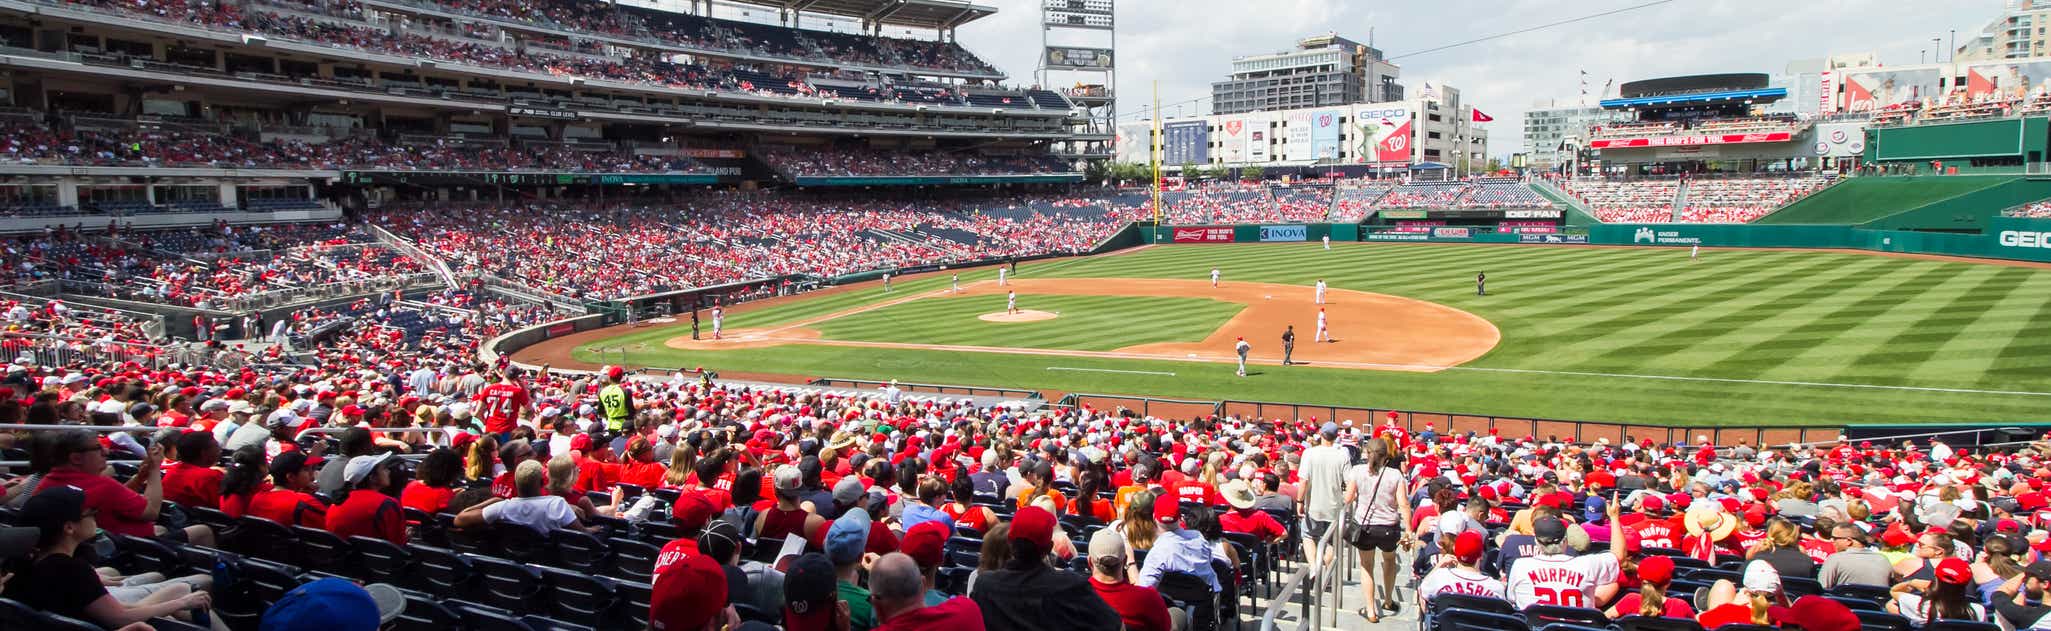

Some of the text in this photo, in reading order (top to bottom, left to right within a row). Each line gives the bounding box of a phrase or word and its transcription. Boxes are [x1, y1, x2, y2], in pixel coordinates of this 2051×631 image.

[1360, 109, 1405, 120] GEICO
[1648, 138, 1665, 147] THIS
[1666, 137, 1689, 146] BUD'S
[1690, 136, 1705, 145] FOR
[601, 175, 623, 183] INOVA
[1534, 210, 1561, 218] FAN
[1271, 229, 1305, 238] INOVA
[604, 394, 620, 408] 45
[486, 396, 514, 419] 74
[714, 478, 732, 491] PER
[1178, 486, 1204, 496] HARPER
[1639, 526, 1671, 538] MURPHY
[1528, 568, 1585, 588] MURPHY
[792, 599, 808, 613] W
